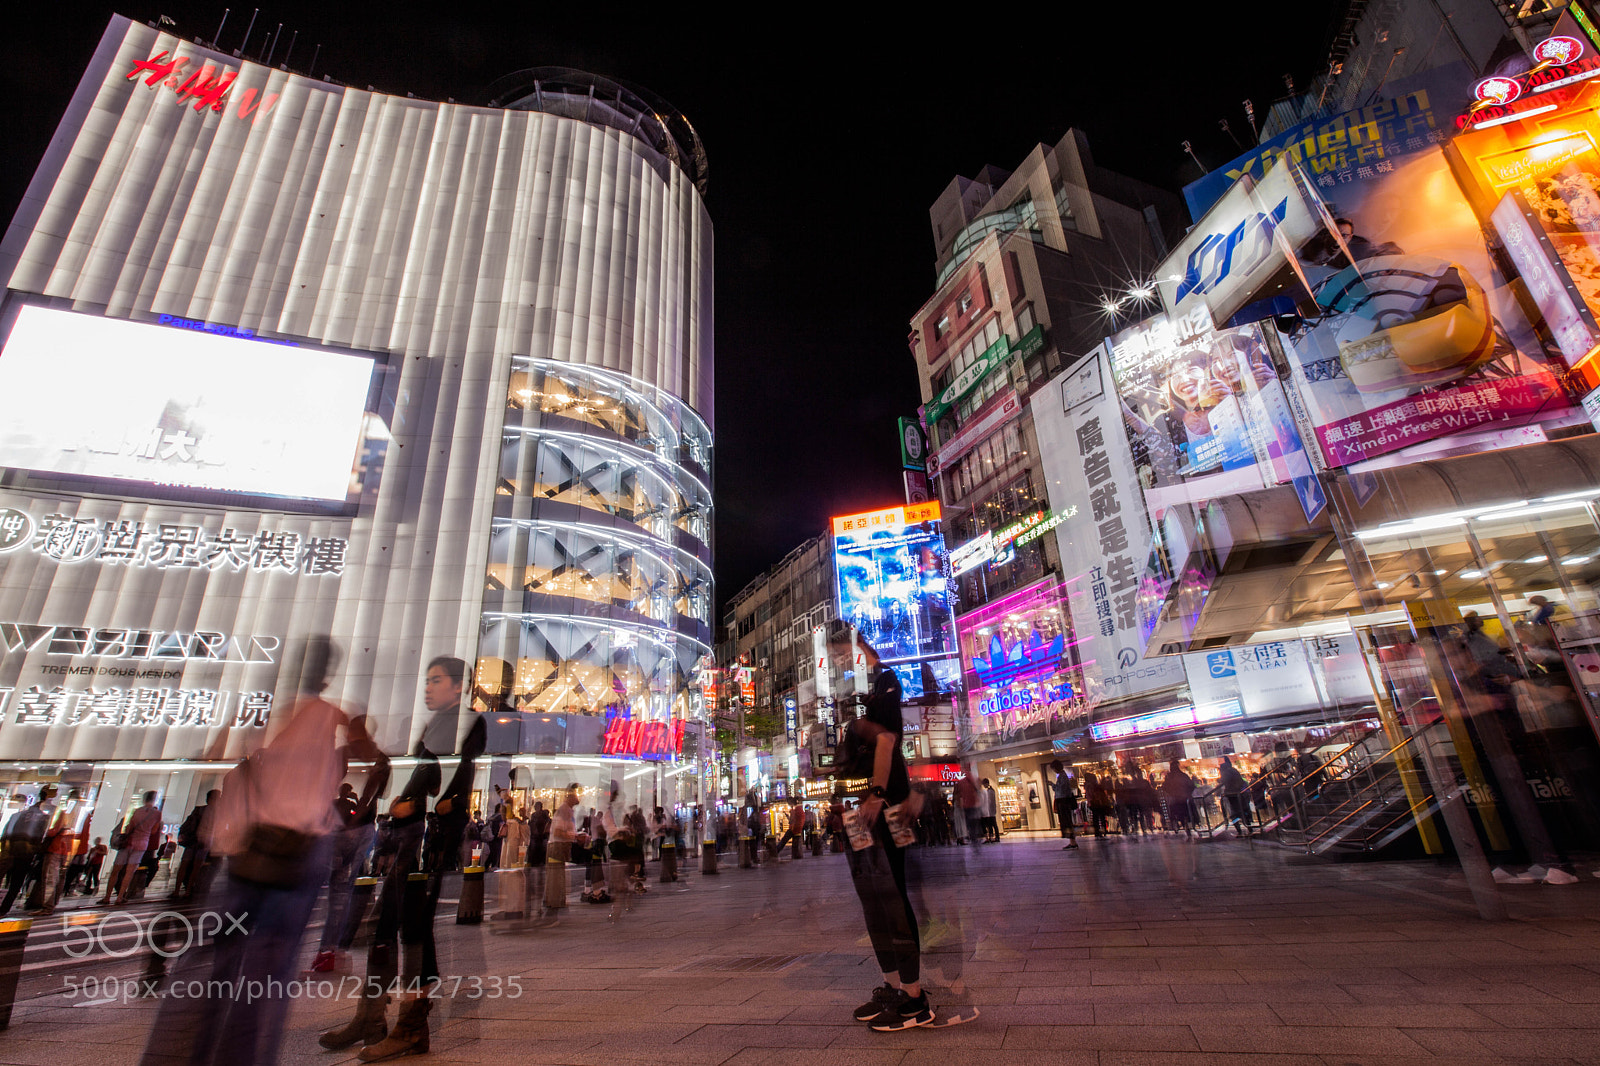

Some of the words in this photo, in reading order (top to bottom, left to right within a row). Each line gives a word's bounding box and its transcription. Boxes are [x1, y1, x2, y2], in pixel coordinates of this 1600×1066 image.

[1455, 106, 1504, 130] COLD
[158, 313, 254, 338] Panasonic
[1089, 565, 1115, 637] 立即搜尋
[979, 689, 1032, 716] adidas
